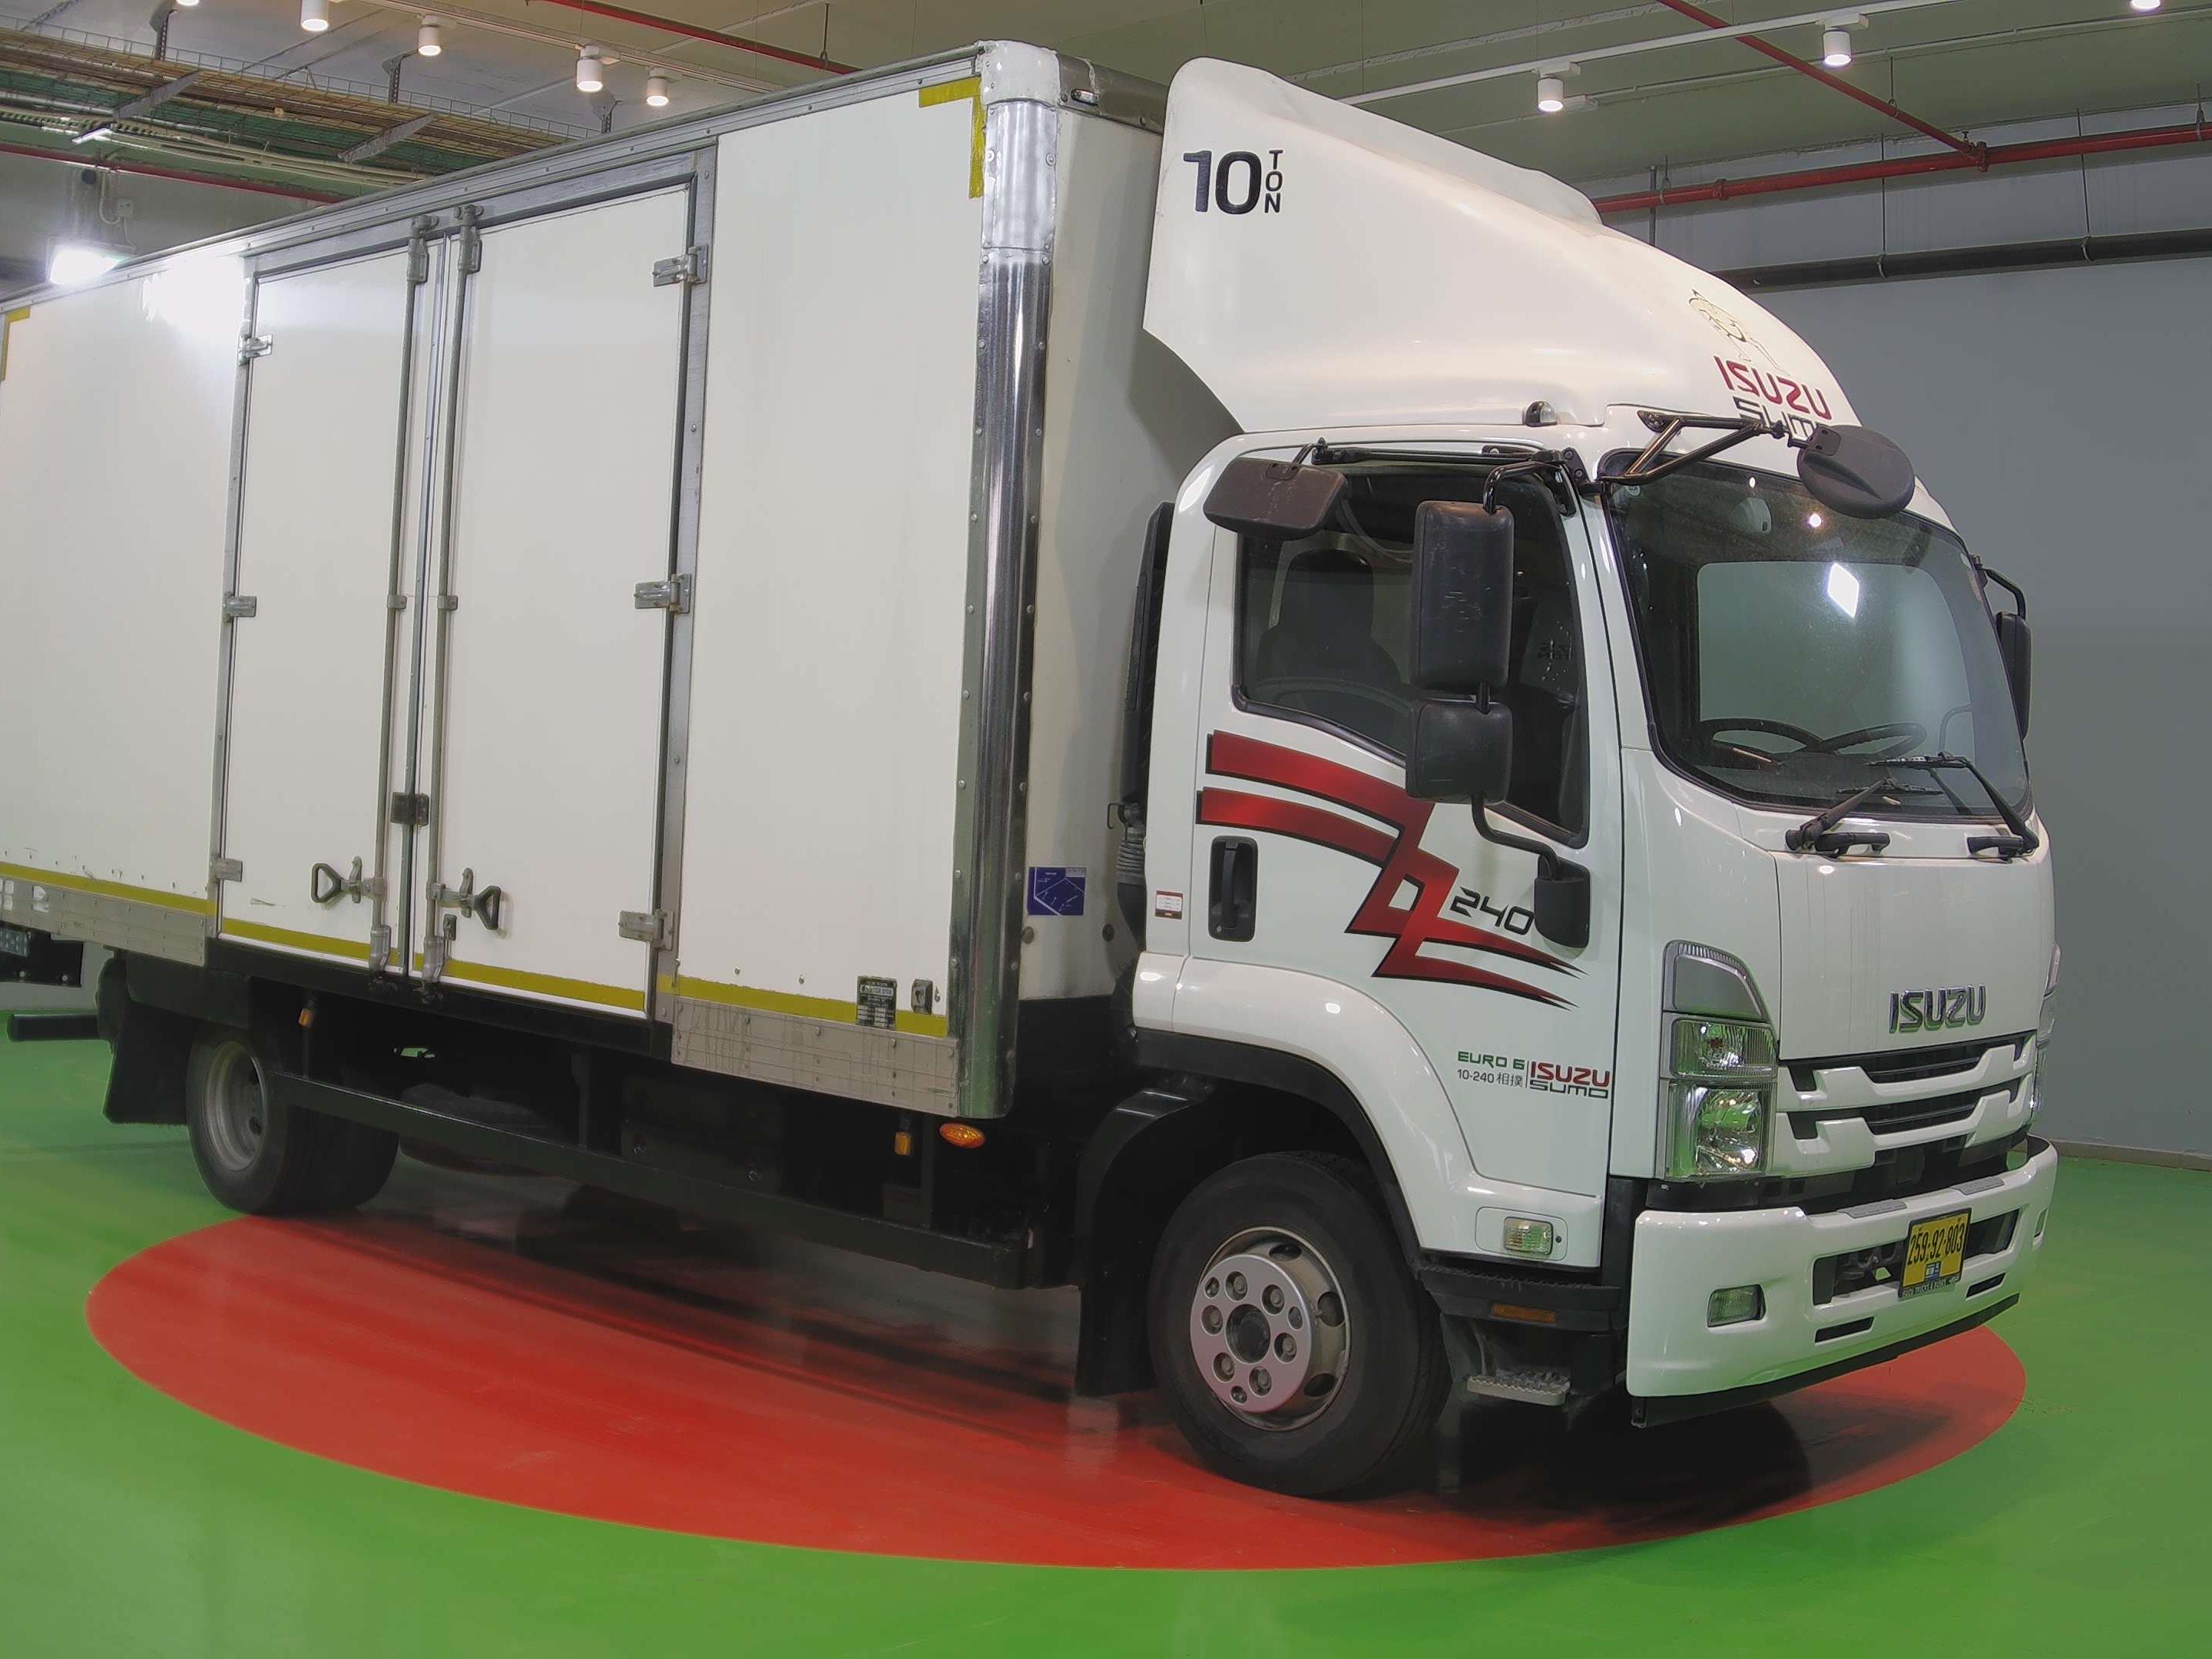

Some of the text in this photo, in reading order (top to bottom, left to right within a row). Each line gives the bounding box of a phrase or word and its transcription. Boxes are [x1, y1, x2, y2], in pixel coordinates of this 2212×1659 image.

[1184, 151, 1262, 214] 10
[1264, 150, 1283, 214] TON
[1714, 355, 1833, 421] ISUZU
[1450, 886, 1535, 935] 240
[1889, 984, 1986, 1034] ISUZU
[1457, 1068, 1495, 1084] 10-240
[1458, 1051, 1525, 1070] EURO 6
[1531, 1061, 1611, 1088] ISUZU
[1529, 1079, 1609, 1099] SUMO
